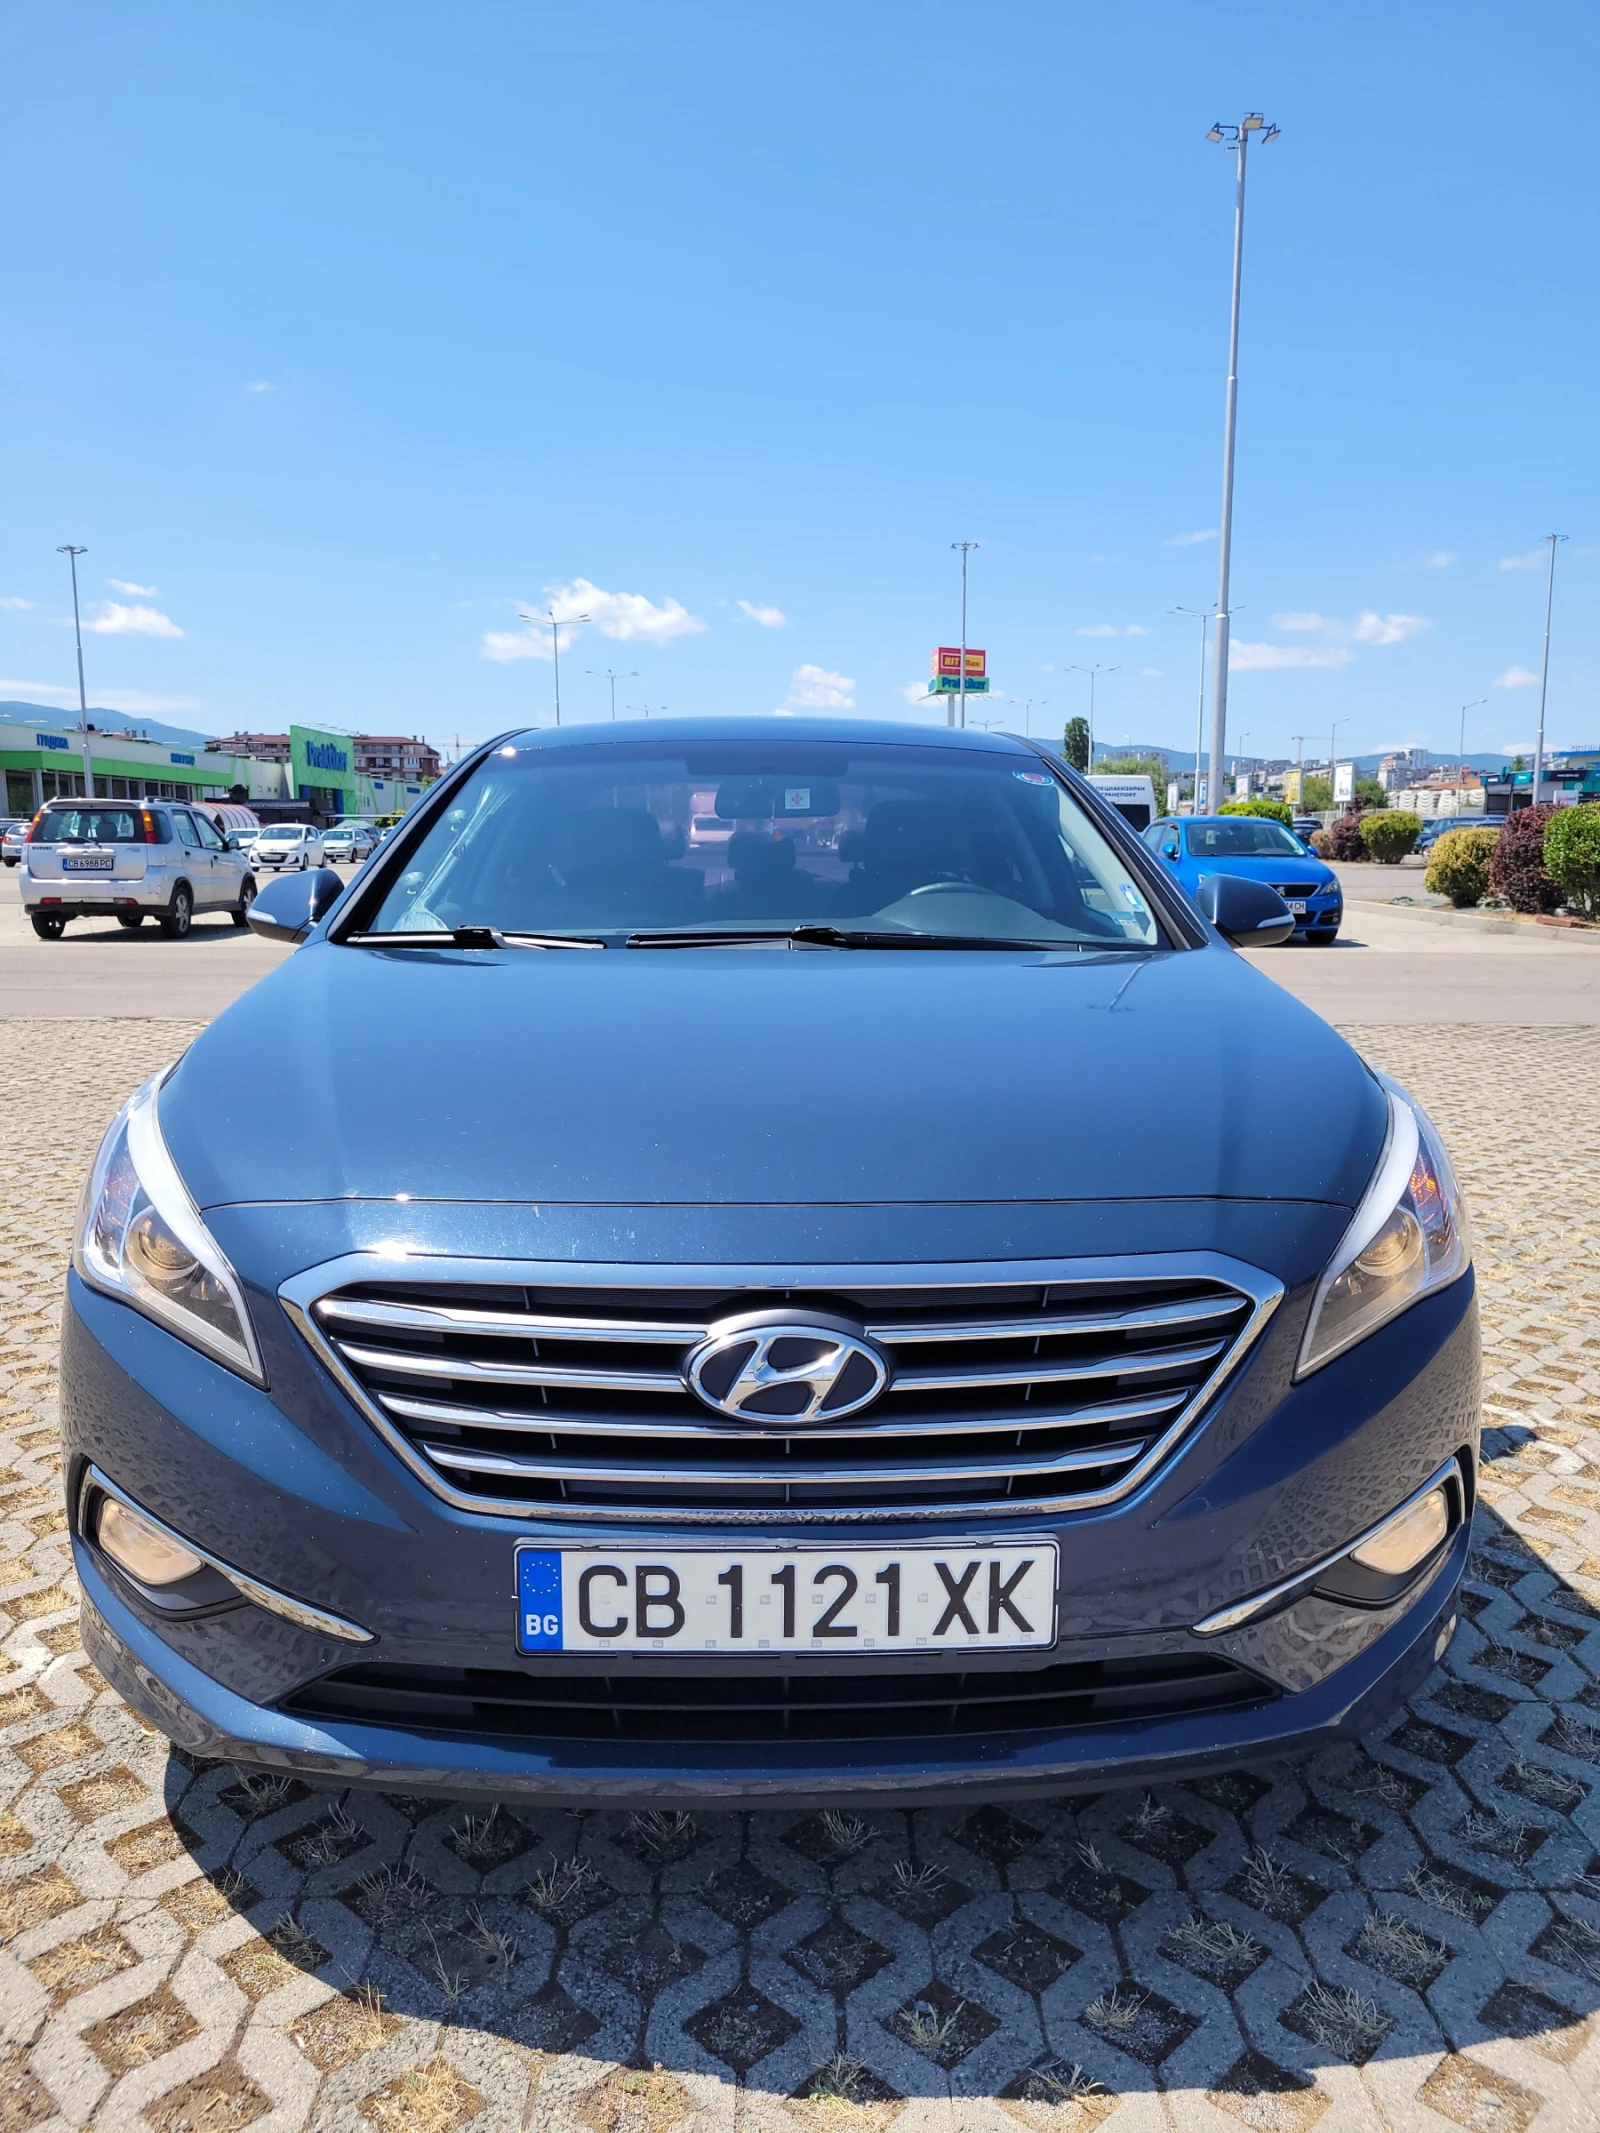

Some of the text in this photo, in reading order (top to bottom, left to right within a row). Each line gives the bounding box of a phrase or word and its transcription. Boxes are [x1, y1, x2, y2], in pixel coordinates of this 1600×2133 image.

[307, 740, 347, 772] Praktiker
[68, 859, 111, 868] CB 6988 PC
[578, 1560, 1035, 1639] CB 1121 XK
[525, 1614, 559, 1636] BG
